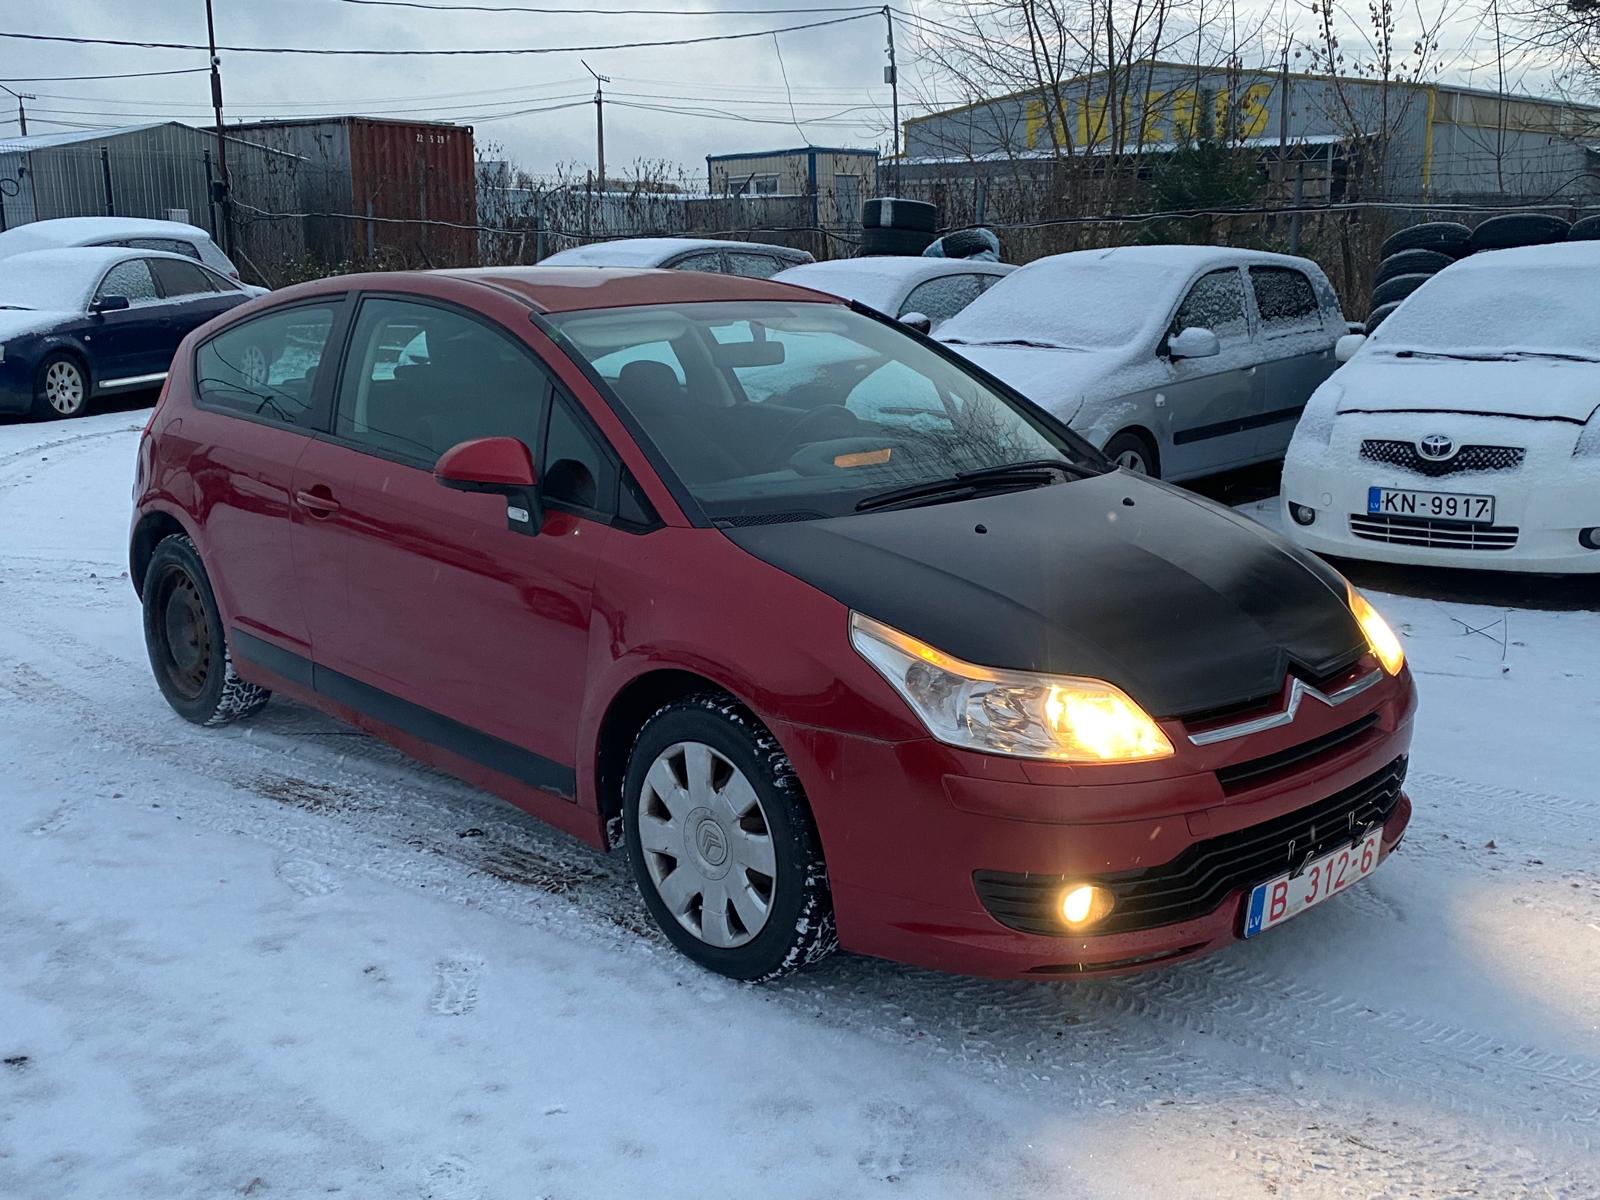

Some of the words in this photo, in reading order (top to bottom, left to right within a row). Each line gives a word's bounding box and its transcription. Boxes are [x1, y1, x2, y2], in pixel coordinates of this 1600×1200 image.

[1385, 492, 1487, 518] KN-9917
[1249, 915, 1261, 929] LV
[1269, 881, 1289, 922] B
[1304, 838, 1375, 904] 312-6
